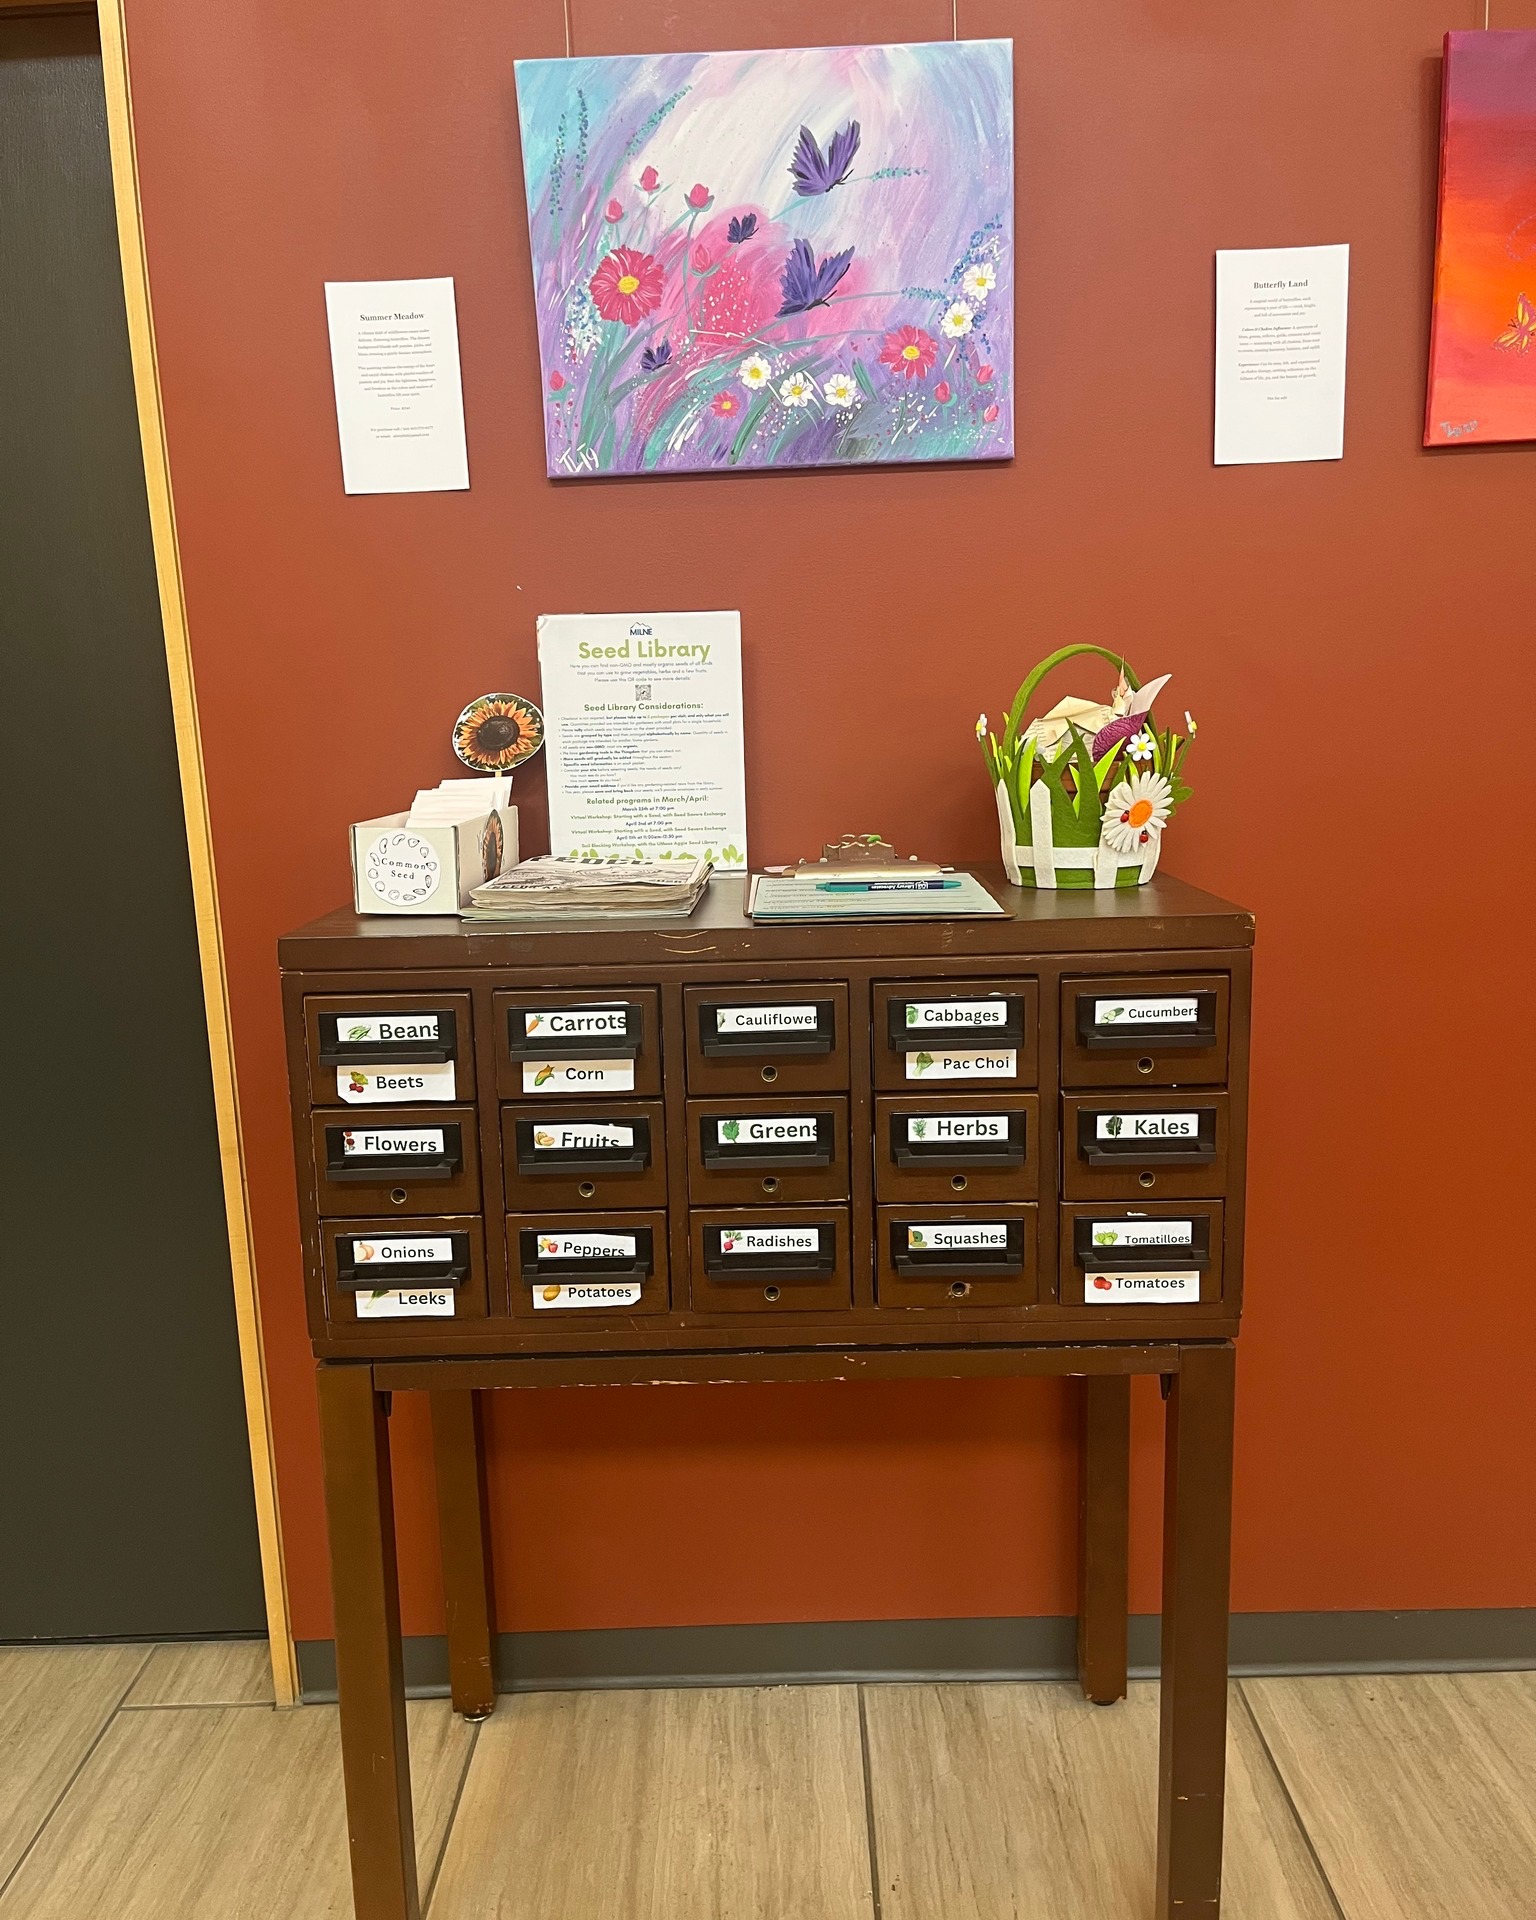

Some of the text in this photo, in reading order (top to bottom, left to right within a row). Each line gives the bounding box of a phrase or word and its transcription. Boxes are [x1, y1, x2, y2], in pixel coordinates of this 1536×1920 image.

[1253, 279, 1308, 289] Butterfly Land
[360, 312, 424, 322] Summer Meadow
[578, 639, 710, 663] Seed Library
[381, 858, 426, 870] Common
[391, 870, 414, 880] Seed
[735, 1012, 818, 1026] Cauliflower
[923, 1008, 1000, 1025] Cabbages
[1128, 1005, 1199, 1020] Cucumbers
[549, 1013, 627, 1033] Carrots
[378, 1022, 440, 1040] Beans
[943, 1056, 1010, 1071] Pac Choi
[565, 1066, 604, 1081] Corn
[375, 1074, 424, 1090] Beets
[749, 1123, 818, 1140] Greens
[936, 1120, 999, 1137] Herbs
[1134, 1118, 1190, 1135] Kales
[363, 1136, 438, 1152] Flowers
[560, 1132, 620, 1148] Fruits
[746, 1235, 812, 1249] Radishes
[933, 1231, 1007, 1247] Squashes
[1124, 1233, 1191, 1245] Tomatilloes
[380, 1245, 435, 1259] Onions
[562, 1241, 626, 1257] Peppers
[1115, 1277, 1186, 1290] Tomatoes
[398, 1291, 446, 1306] Leeks
[567, 1285, 632, 1299] Potatoes
